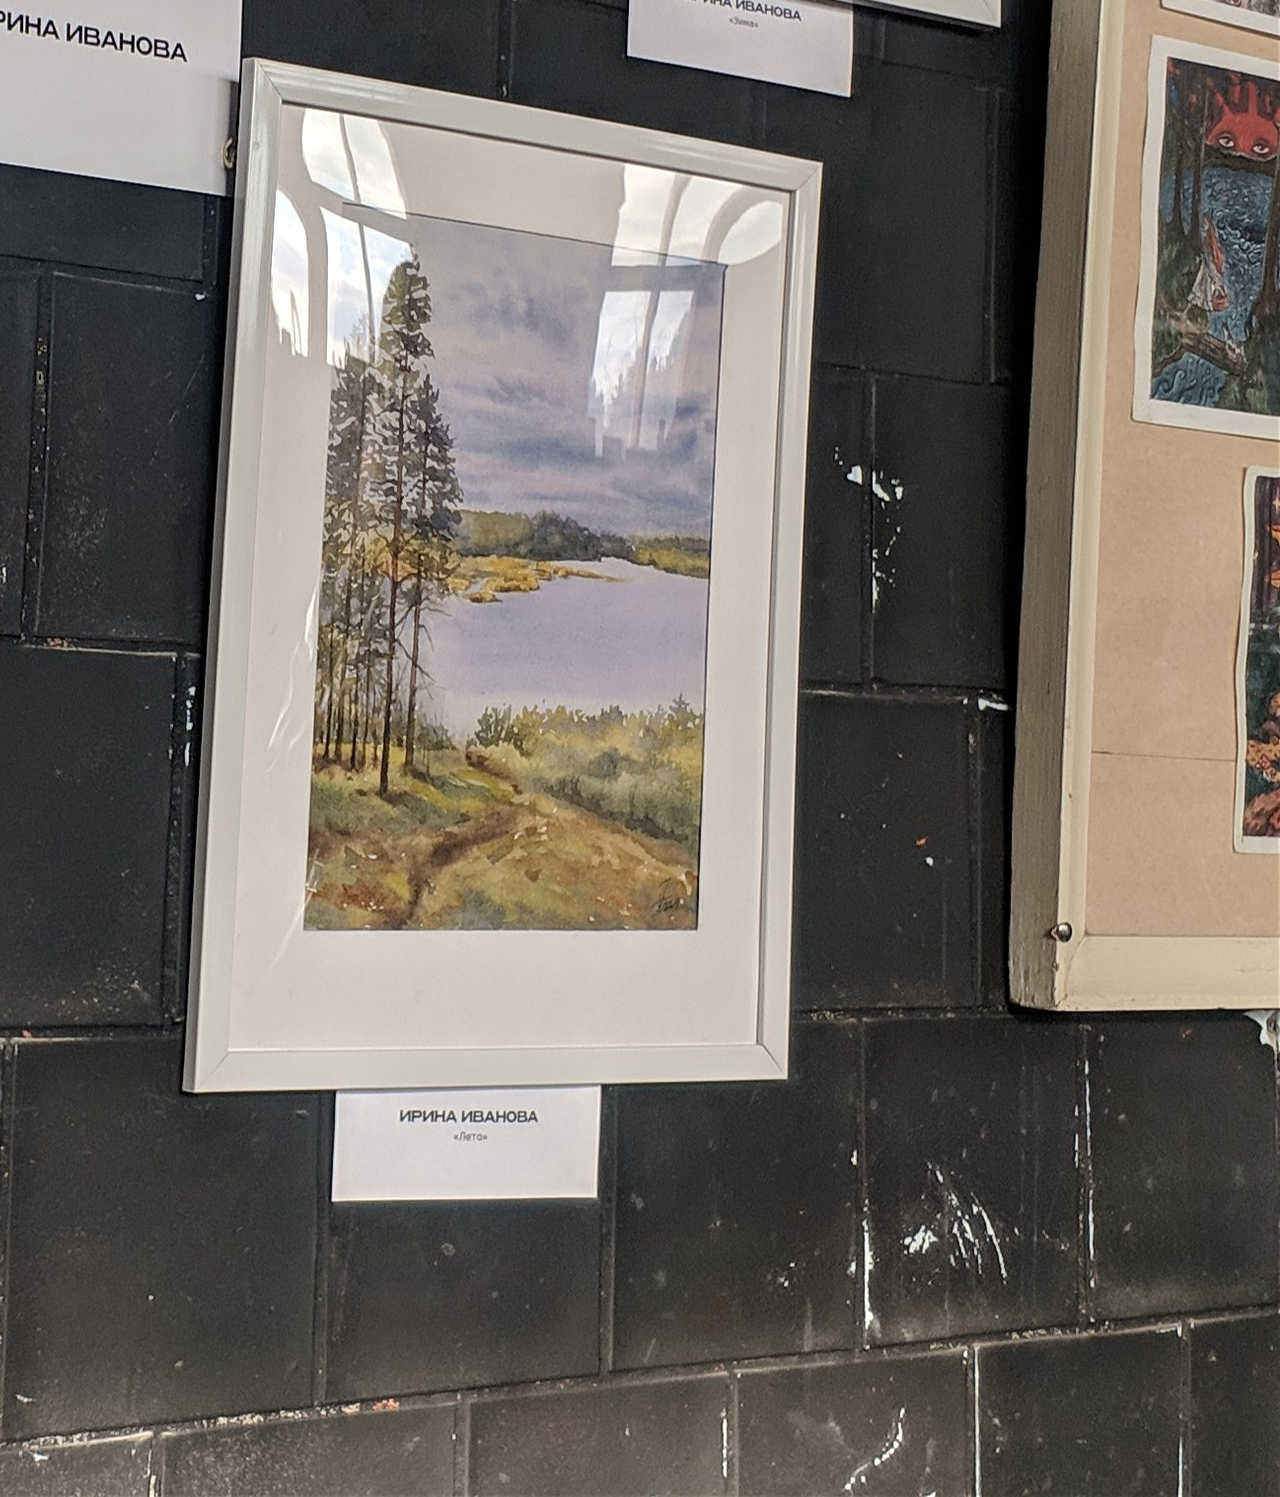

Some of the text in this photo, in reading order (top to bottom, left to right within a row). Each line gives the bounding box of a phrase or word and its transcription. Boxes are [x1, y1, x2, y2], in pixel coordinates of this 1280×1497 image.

[66, 23, 187, 62] ИВАНОВА
[399, 1110, 538, 1123] ИРИНА ИВАНОВА
[453, 1131, 488, 1142] «Лето»
